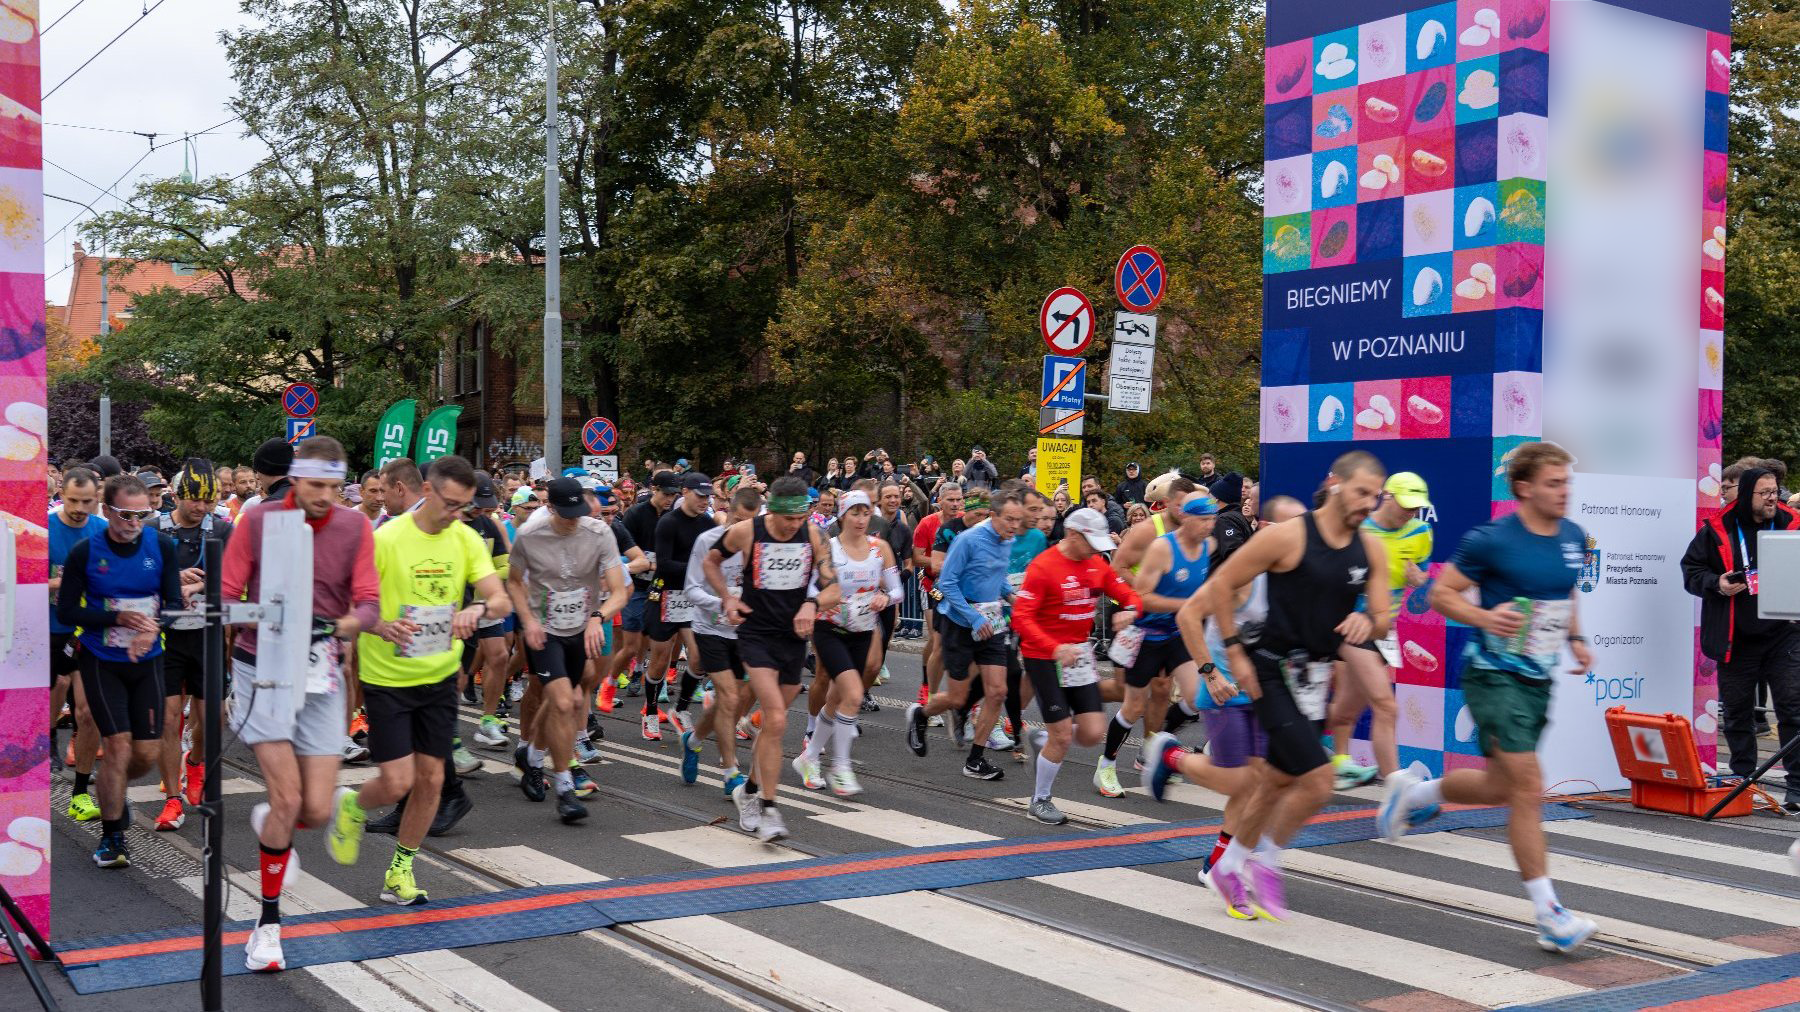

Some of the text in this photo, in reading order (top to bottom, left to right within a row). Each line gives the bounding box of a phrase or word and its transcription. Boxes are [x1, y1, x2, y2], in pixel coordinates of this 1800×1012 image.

[1286, 278, 1392, 310] BIEGNIEMY
[1332, 330, 1465, 361] W POZNANIU
[1042, 442, 1077, 454] UWAGA!
[1581, 503, 1662, 519] Patronat Honorowy
[1606, 552, 1666, 563] Patronat Honorowy
[767, 558, 802, 571] 2569
[1606, 564, 1643, 575] Prezydenta
[1606, 576, 1658, 585] Miasta Poznania
[1593, 634, 1644, 648] Organizator
